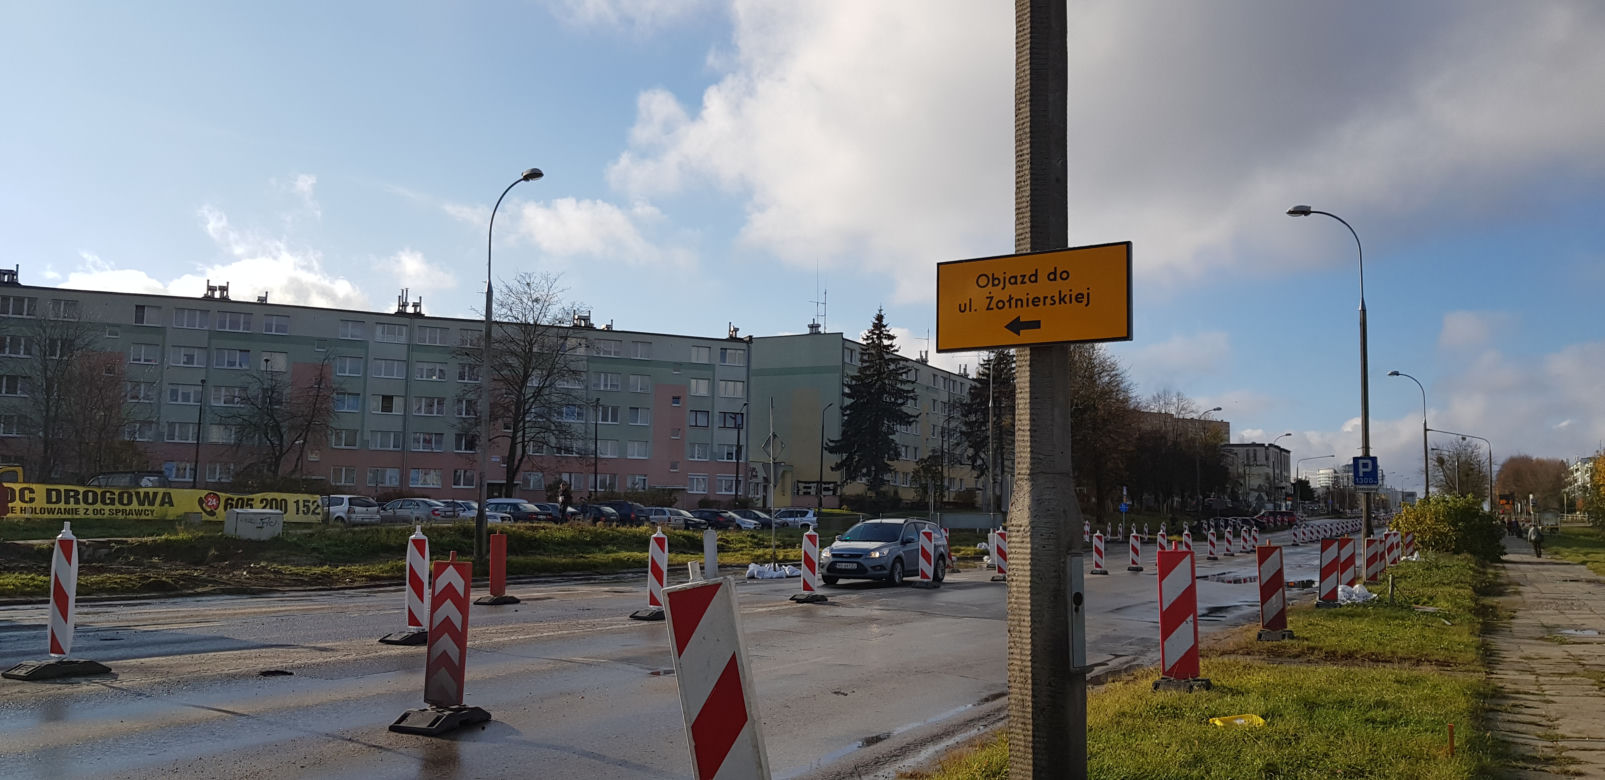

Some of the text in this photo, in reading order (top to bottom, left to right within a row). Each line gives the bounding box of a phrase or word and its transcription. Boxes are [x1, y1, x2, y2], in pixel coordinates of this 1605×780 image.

[976, 266, 1070, 290] Objazd do
[958, 288, 1090, 313] ul. Żołnierskiej
[1358, 459, 1372, 477] P
[46, 488, 175, 507] DROGOWA
[224, 497, 320, 516] 605 200 152
[83, 507, 90, 516] Z
[93, 508, 106, 516] OC
[108, 508, 155, 517] SPRAWCY
